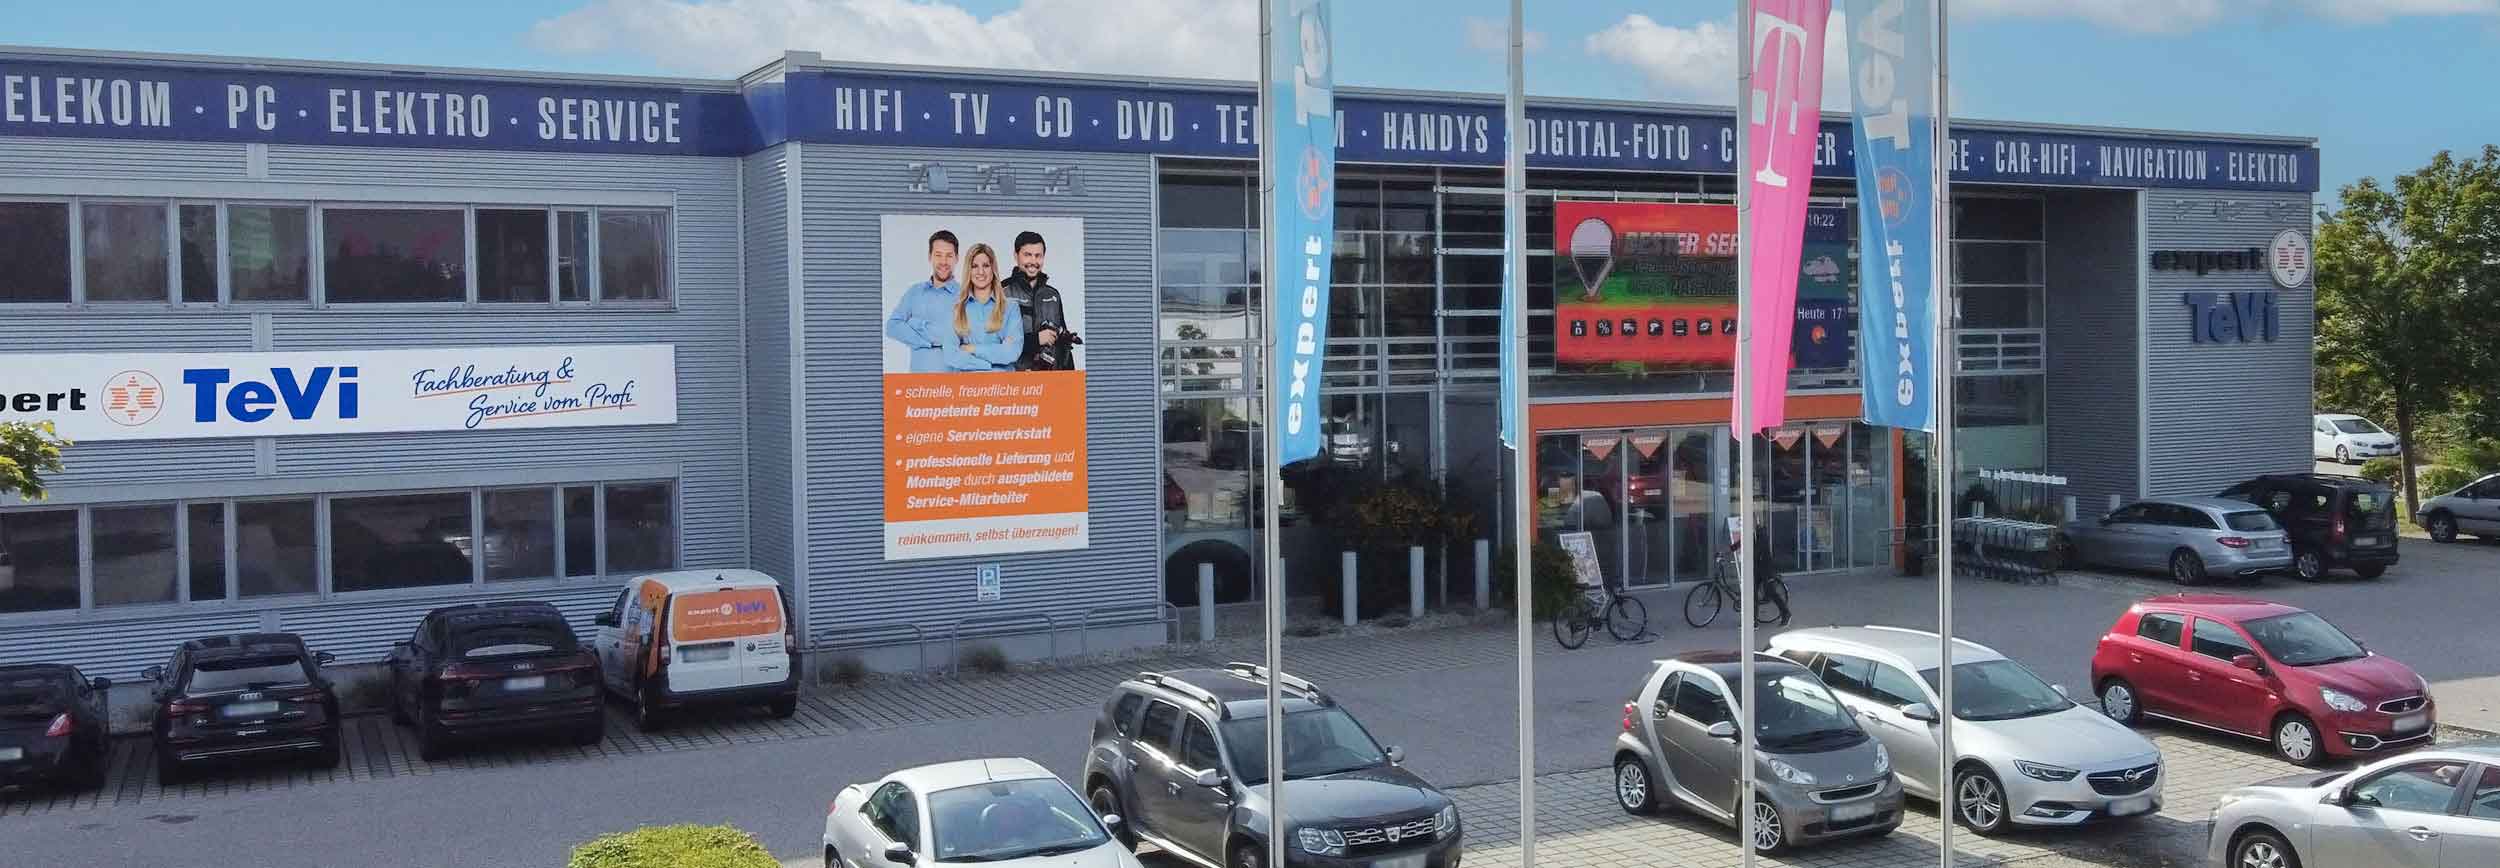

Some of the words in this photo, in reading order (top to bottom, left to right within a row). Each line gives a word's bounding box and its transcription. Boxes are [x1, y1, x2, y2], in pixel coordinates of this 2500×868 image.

[1290, 0, 1332, 126] Te
[227, 84, 276, 131] PC
[329, 88, 490, 138] ELEKTRO
[538, 97, 681, 143] SERVICE
[1753, 11, 1808, 187] T
[835, 87, 902, 132] HIFI
[950, 92, 989, 135] TV
[1035, 95, 1073, 138] CD
[1117, 100, 1174, 141] DVD
[1383, 111, 1489, 153] HANDYS
[1995, 140, 2077, 177] CAR-HIFI
[2100, 145, 2208, 181] NAVIGATION
[2229, 151, 2298, 184] ELEKTRO
[1808, 213, 1835, 227] 10:22
[1287, 234, 1322, 435] expert
[2184, 290, 2279, 343] TeVi
[0, 388, 86, 412] ert
[183, 366, 358, 423] TeVi
[412, 364, 551, 398] Fachberatung
[556, 356, 575, 379] &
[905, 384, 955, 399] schnelle,
[959, 383, 1020, 398] freundliche
[1022, 383, 1043, 396] und
[465, 394, 537, 429] Service
[543, 397, 583, 416] vom
[584, 380, 635, 410] Profi
[905, 403, 980, 420] kompetente
[983, 402, 1039, 417] Beratung
[905, 432, 944, 446] eigene
[947, 426, 1052, 442] Servicewerkstatt
[905, 454, 993, 471] professionelle
[995, 451, 1051, 466] Lieferung
[1054, 449, 1075, 463] und
[906, 473, 960, 489] Montage
[963, 472, 996, 486] durch
[998, 470, 1074, 486] ausgebildete
[906, 492, 1029, 509] Service-Mitarbeiter
[898, 530, 972, 545] reinkommen,
[975, 528, 1009, 541] selbst
[1011, 524, 1079, 541] überzeugen!
